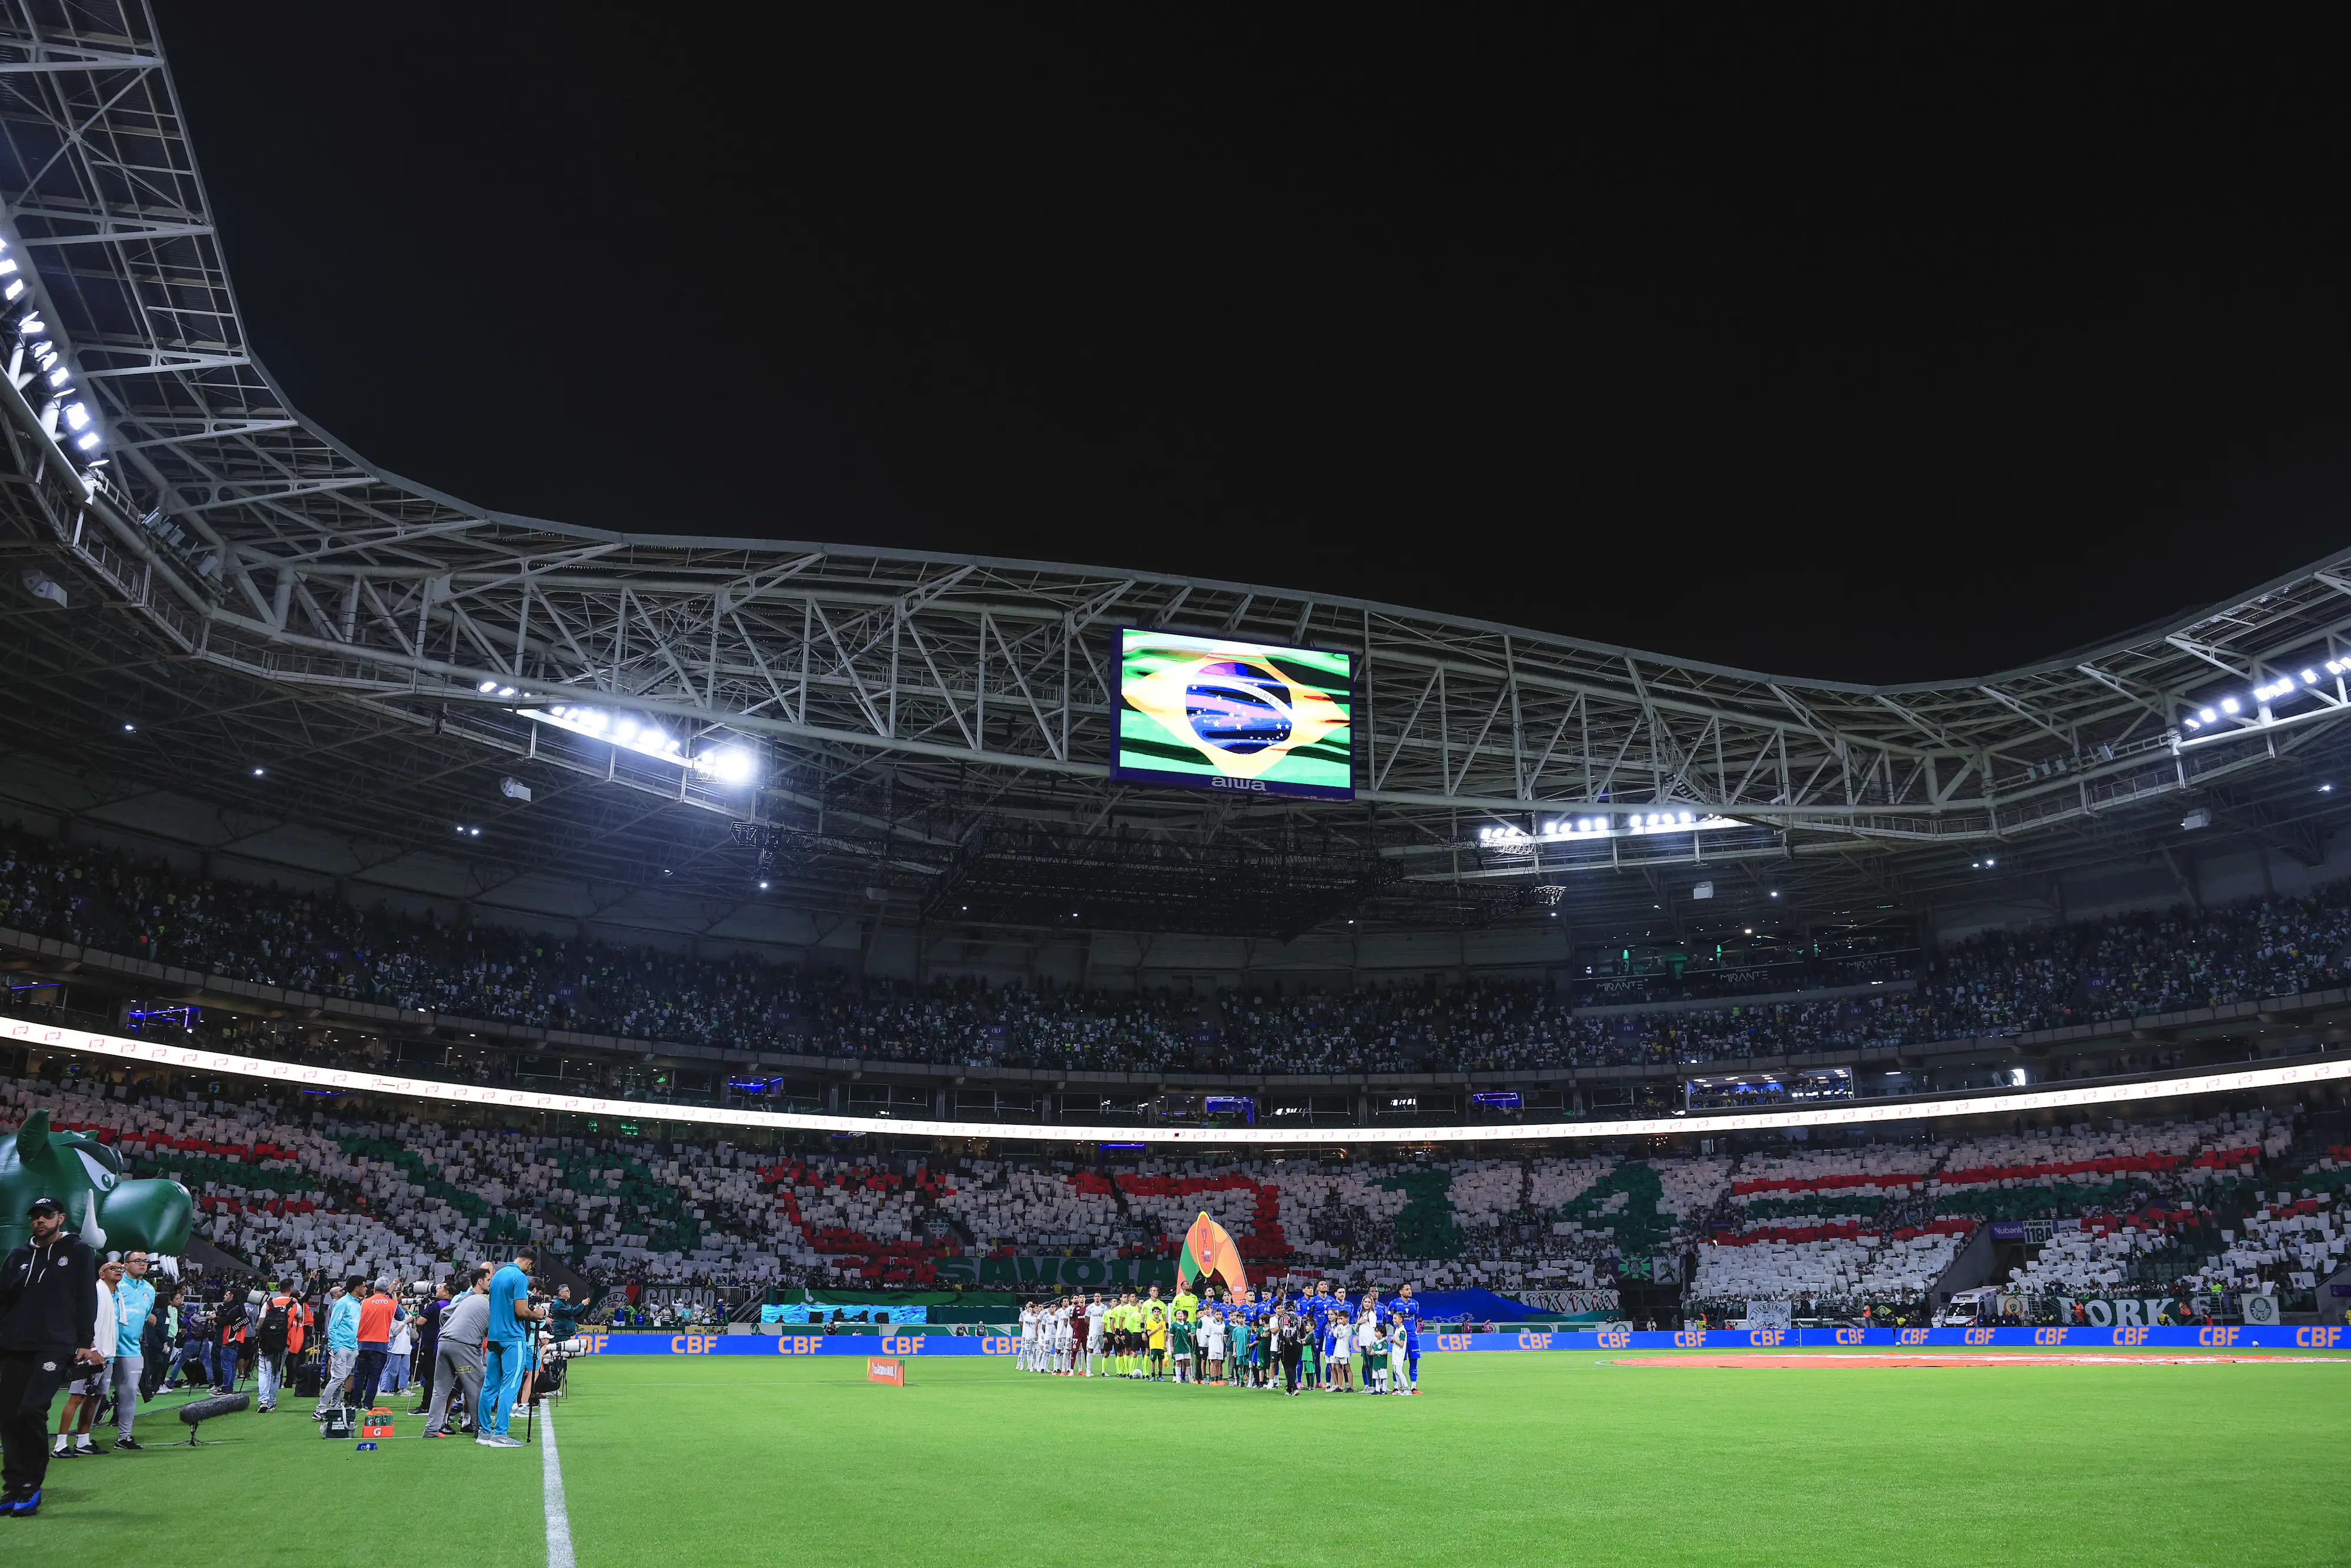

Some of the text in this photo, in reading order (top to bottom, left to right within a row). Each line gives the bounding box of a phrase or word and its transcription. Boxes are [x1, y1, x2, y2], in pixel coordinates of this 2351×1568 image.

[1211, 776, 1266, 792] aiwa
[1720, 971, 1768, 983] MIRANTE
[1596, 981, 1643, 991] MIRANTE
[2025, 1227, 2053, 1242] 118A
[567, 1335, 609, 1353] BF
[1437, 1335, 1472, 1351] CBF
[1519, 1334, 1552, 1349] CBF
[1598, 1332, 1630, 1348] CBF
[1674, 1331, 1706, 1346] CBF
[1750, 1330, 1785, 1346] CBF
[1836, 1329, 1864, 1344] CBF
[1901, 1329, 1929, 1344] CBF
[1965, 1328, 1995, 1344] CBF
[2035, 1328, 2068, 1344] CBF
[2113, 1327, 2148, 1345] CBF
[2199, 1327, 2239, 1346] CBF
[2296, 1327, 2342, 1346] CBF
[672, 1336, 717, 1353] CBF
[779, 1336, 822, 1353] CBF
[882, 1336, 924, 1354] CBF
[982, 1336, 1022, 1354] CBF
[373, 1428, 381, 1436] G
